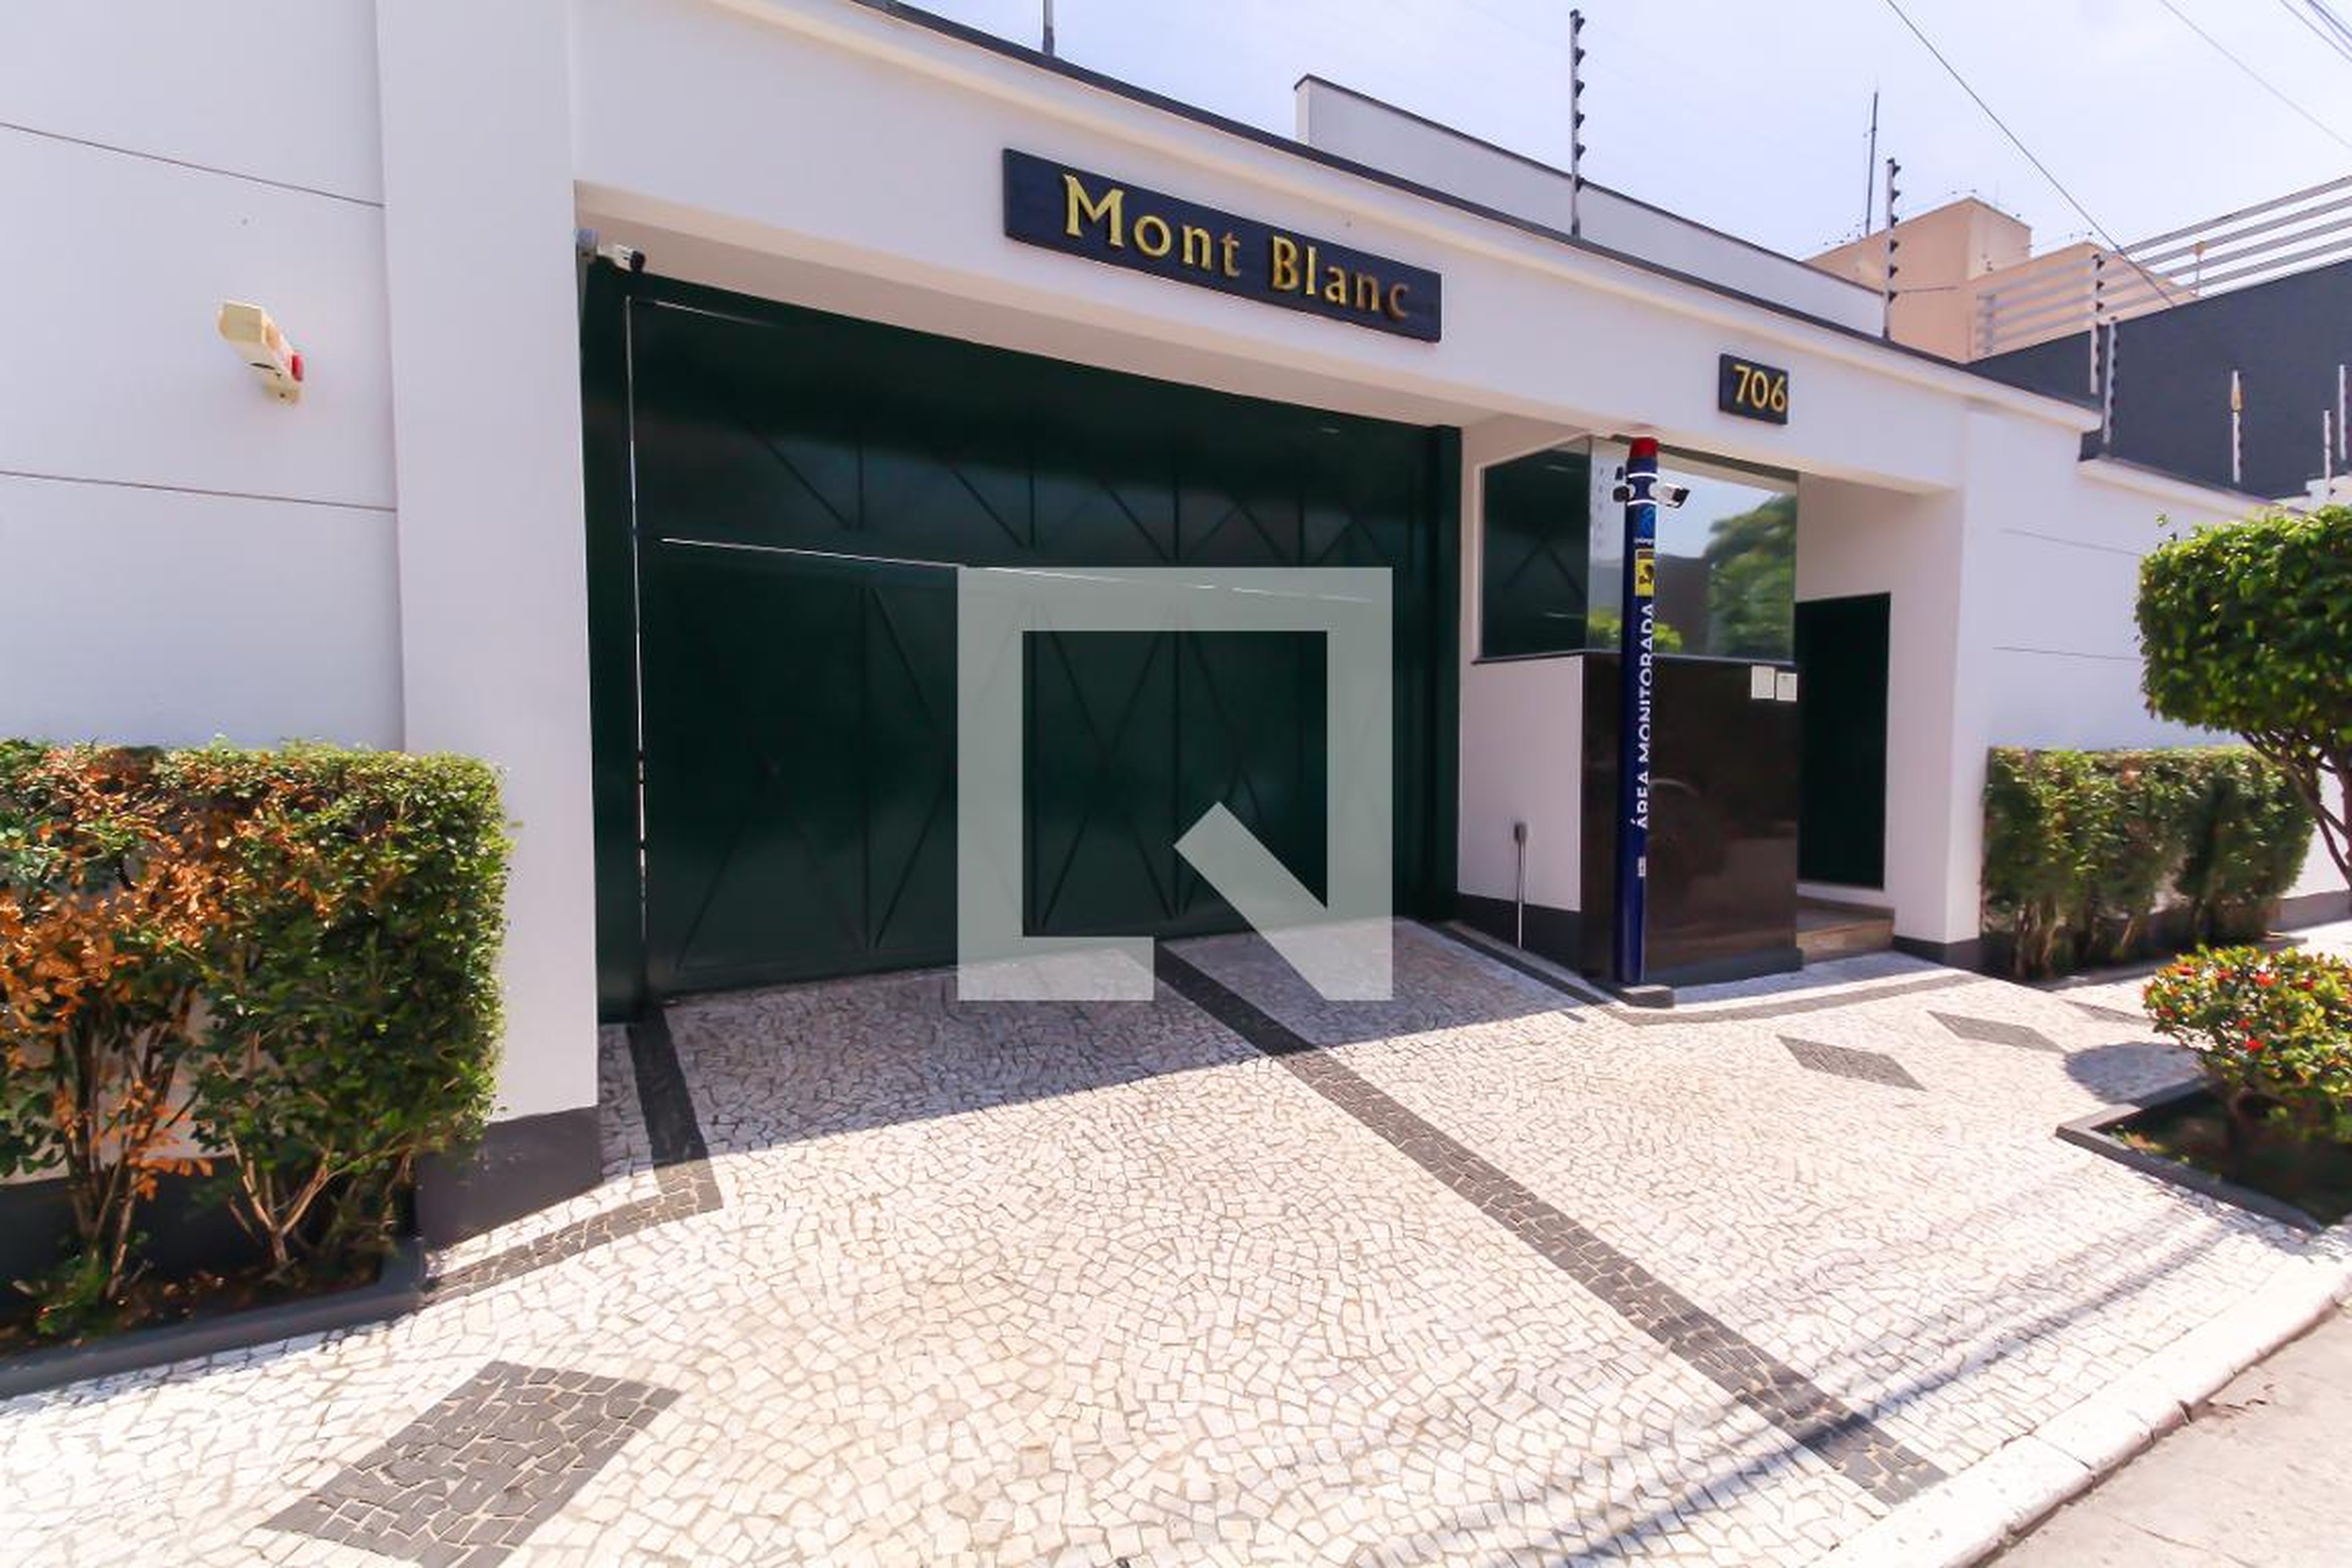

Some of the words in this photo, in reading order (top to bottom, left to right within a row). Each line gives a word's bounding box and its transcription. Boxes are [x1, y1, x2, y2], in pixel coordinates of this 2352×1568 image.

[1063, 173, 1242, 278] Mont
[1272, 235, 1409, 319] Blanc
[1733, 364, 1786, 413] 706
[1638, 603, 1654, 763] MONITORADA
[1630, 771, 1649, 829] ÁREA
